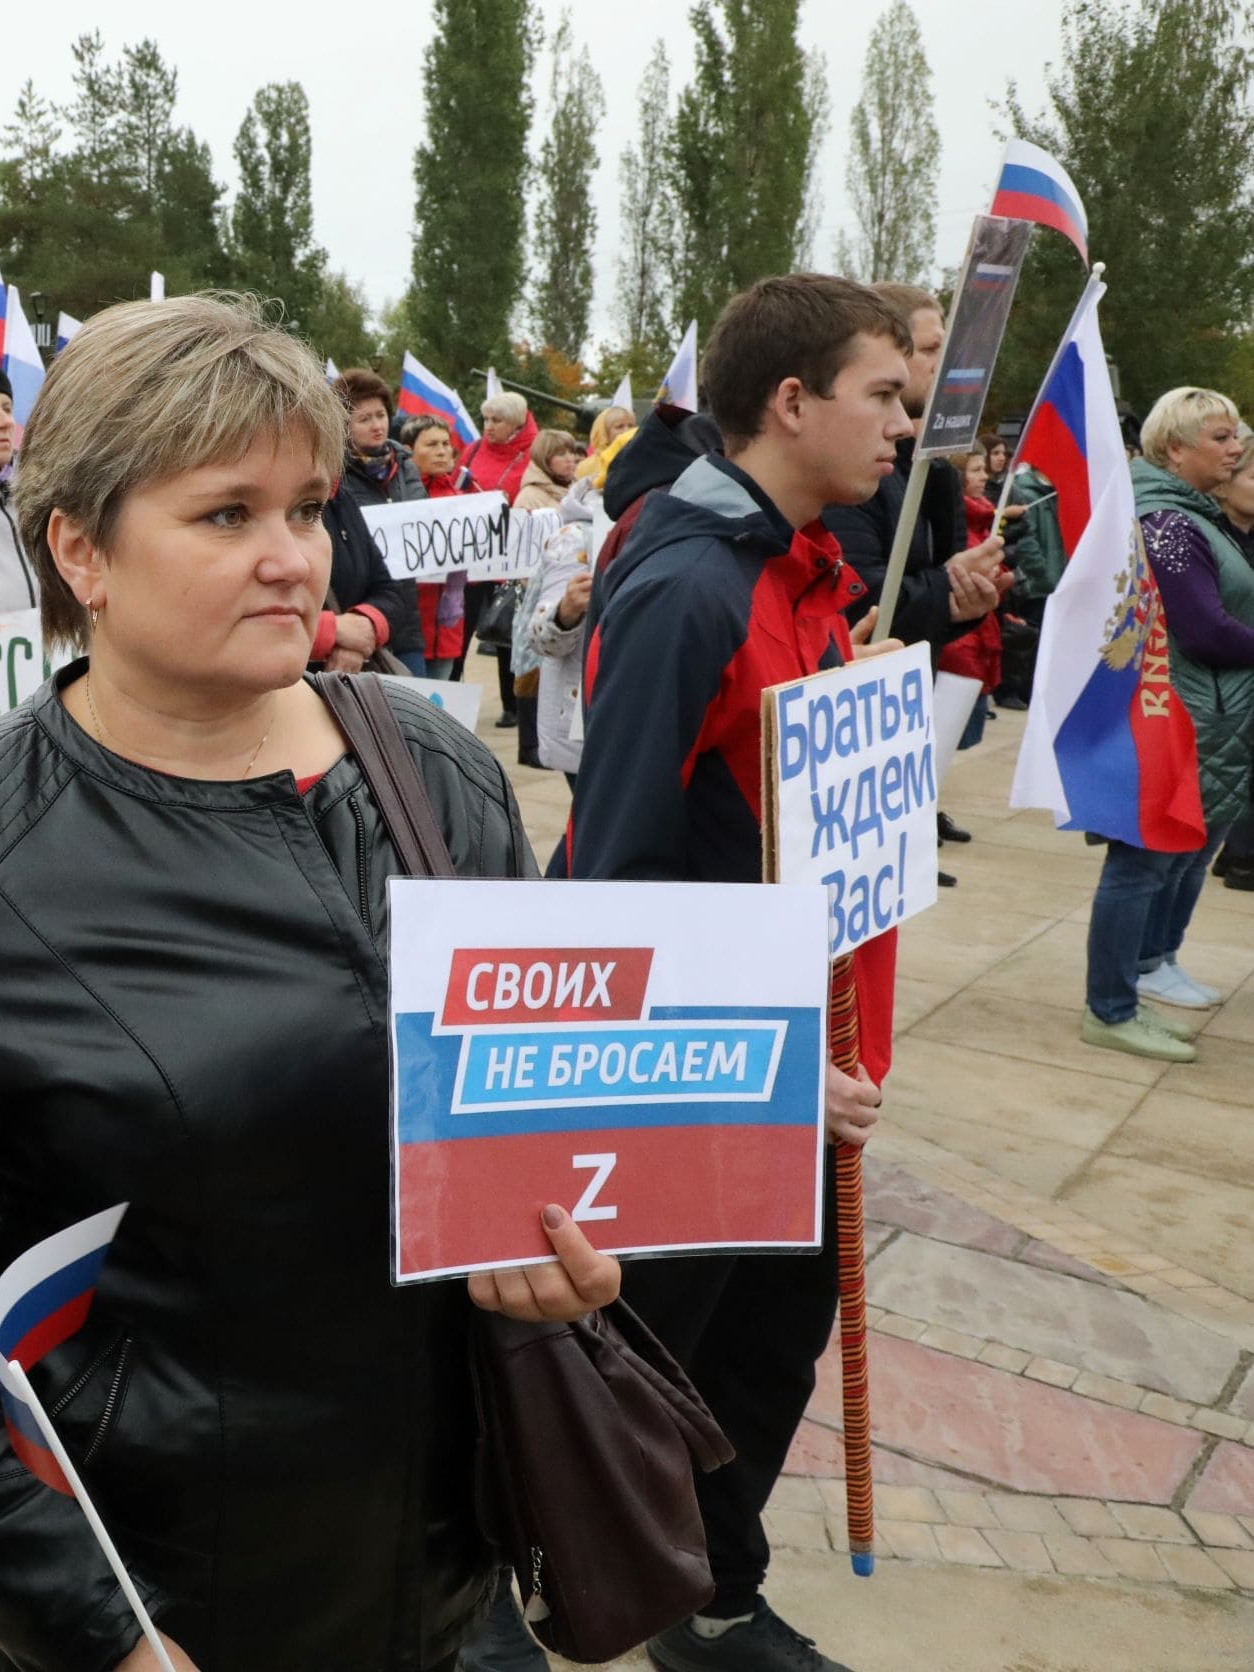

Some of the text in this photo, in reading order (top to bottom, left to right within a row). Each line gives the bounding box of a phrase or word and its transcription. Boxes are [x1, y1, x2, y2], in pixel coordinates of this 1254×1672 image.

[777, 668, 931, 792] Братья,
[810, 743, 936, 860] ждем
[465, 961, 617, 1011] СВОИХ
[484, 1041, 747, 1091] НЕ БРОСАЕМ
[571, 1152, 618, 1222] Z
